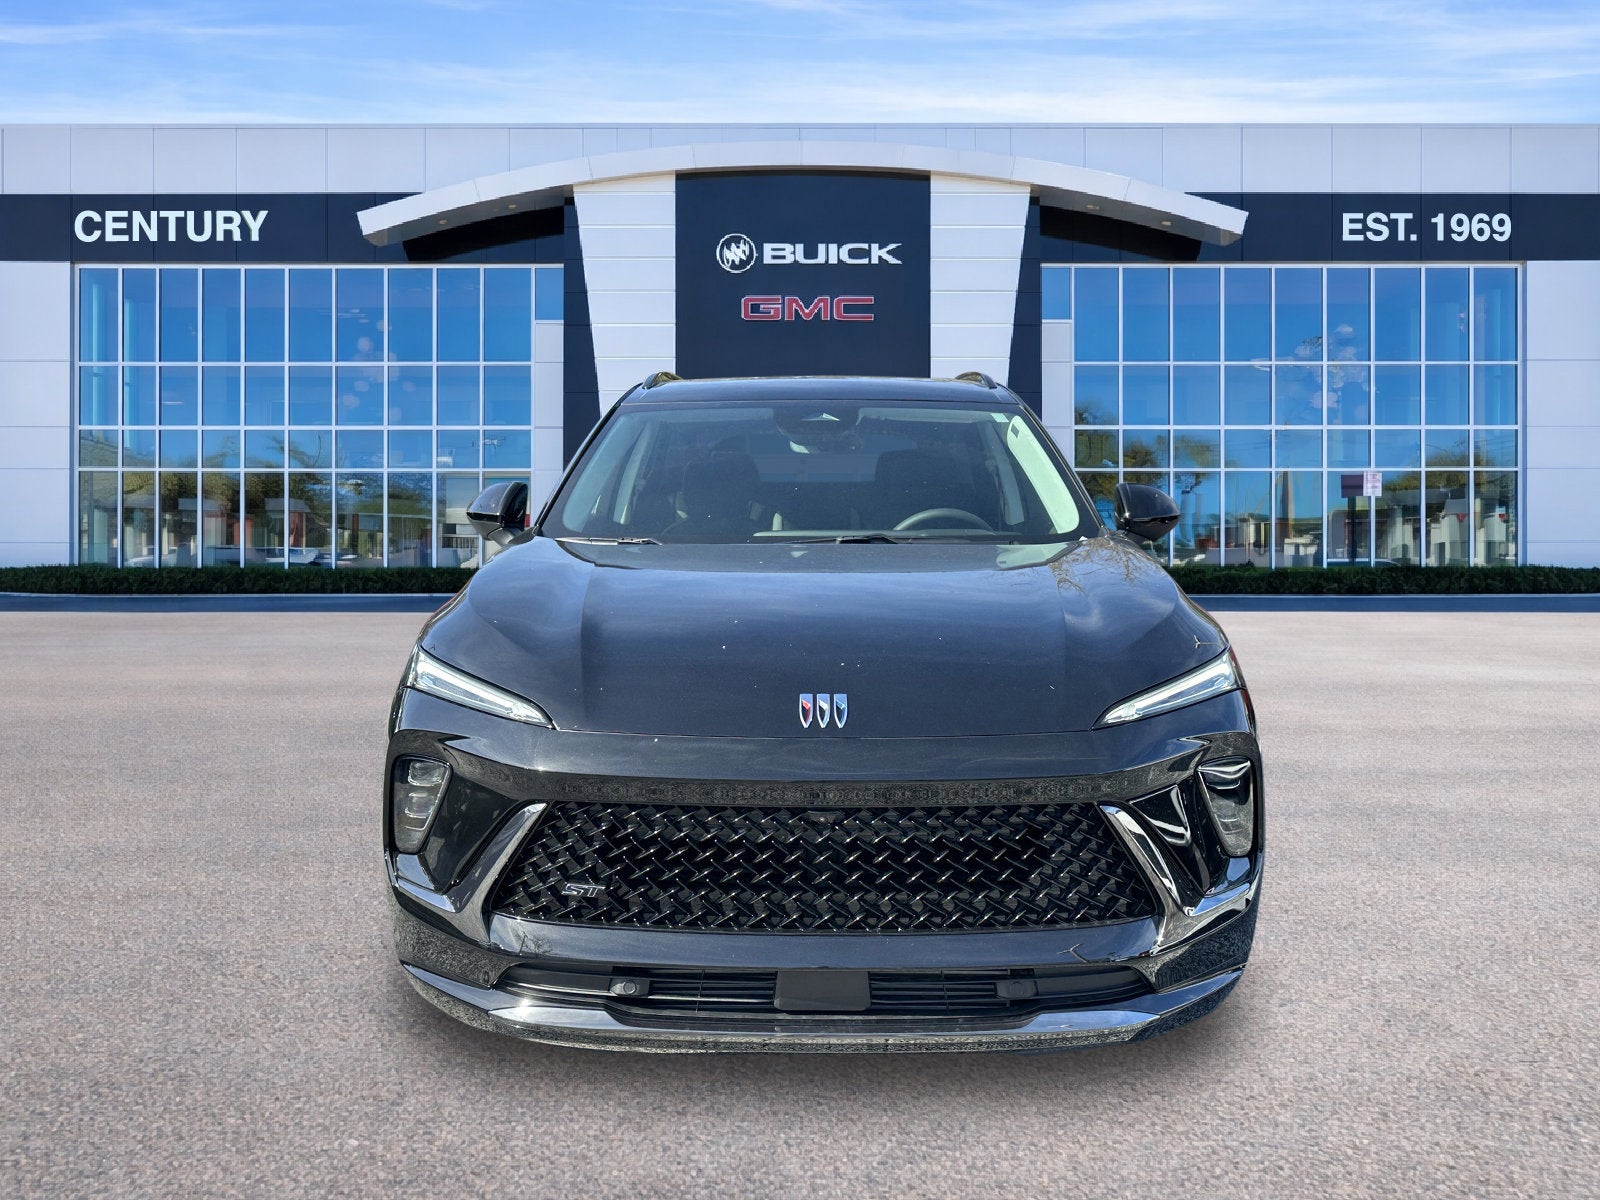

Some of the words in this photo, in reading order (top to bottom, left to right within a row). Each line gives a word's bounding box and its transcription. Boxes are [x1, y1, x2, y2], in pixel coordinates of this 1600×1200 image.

[74, 209, 268, 243] CENTURY
[1342, 212, 1418, 242] EST.
[1430, 212, 1512, 242] 1969
[762, 242, 903, 265] BUICK
[740, 294, 875, 321] GMC
[561, 883, 606, 898] ST
